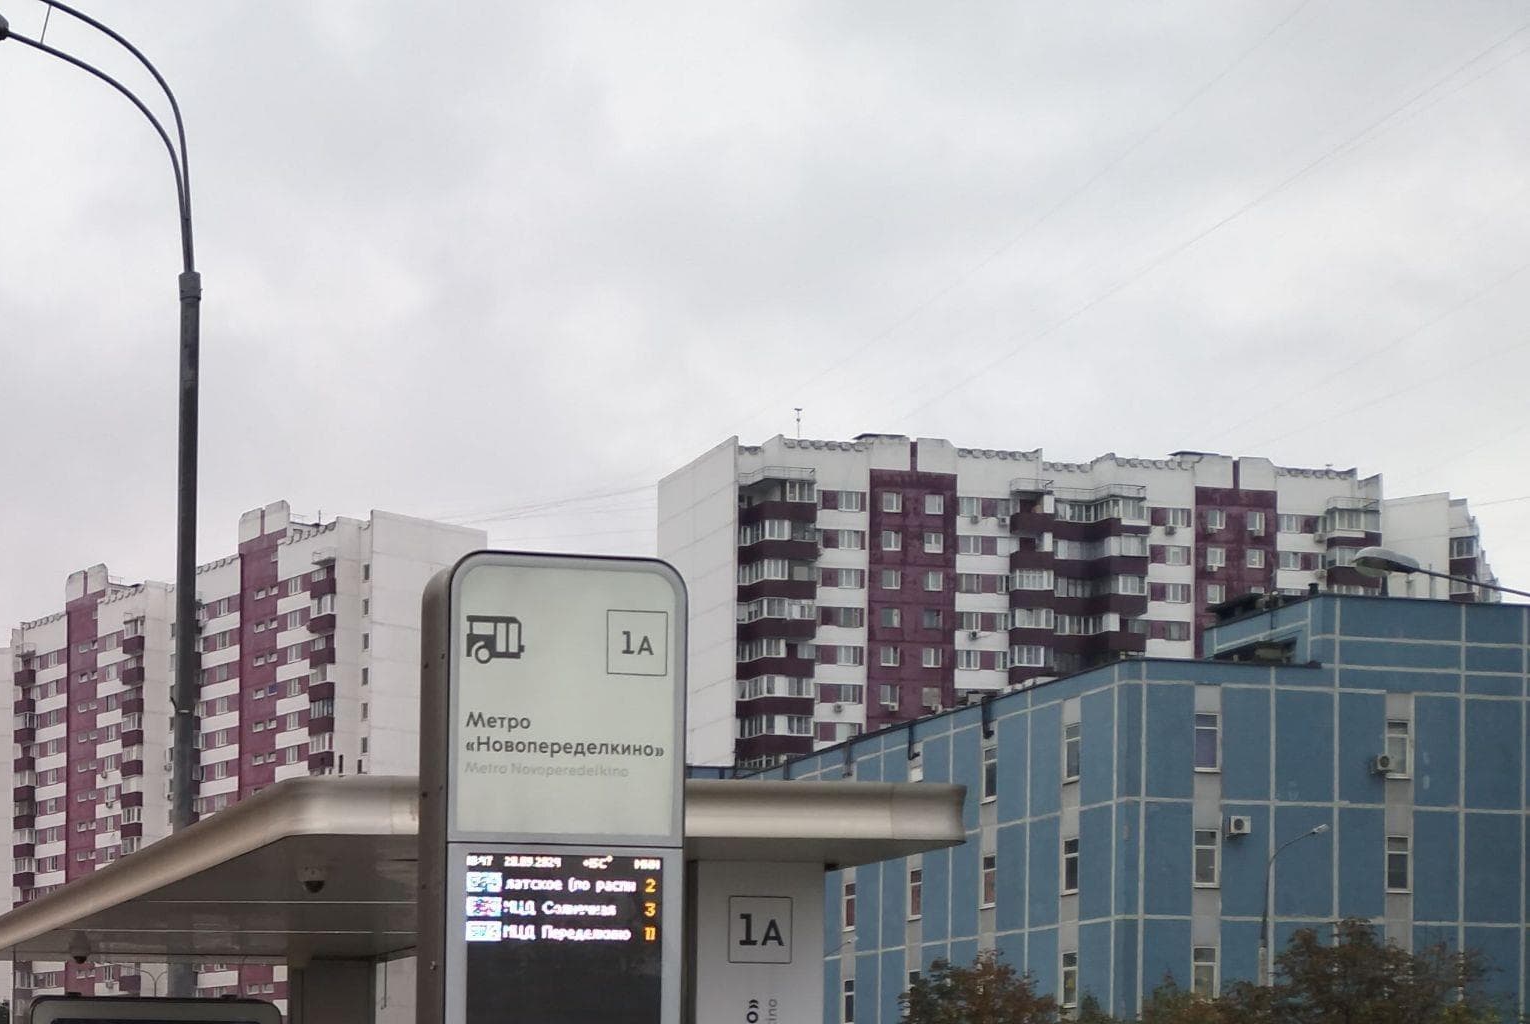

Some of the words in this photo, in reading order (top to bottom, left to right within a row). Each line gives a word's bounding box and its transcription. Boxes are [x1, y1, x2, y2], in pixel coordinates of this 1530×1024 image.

[622, 630, 655, 656] 1А
[466, 711, 531, 732] Метро
[466, 736, 665, 757] «Новопеределкино»
[464, 762, 508, 776] Metro
[511, 762, 630, 778] Novoperedelkino
[645, 878, 656, 893] 2
[644, 902, 656, 917] 3
[739, 913, 785, 946] 1А
